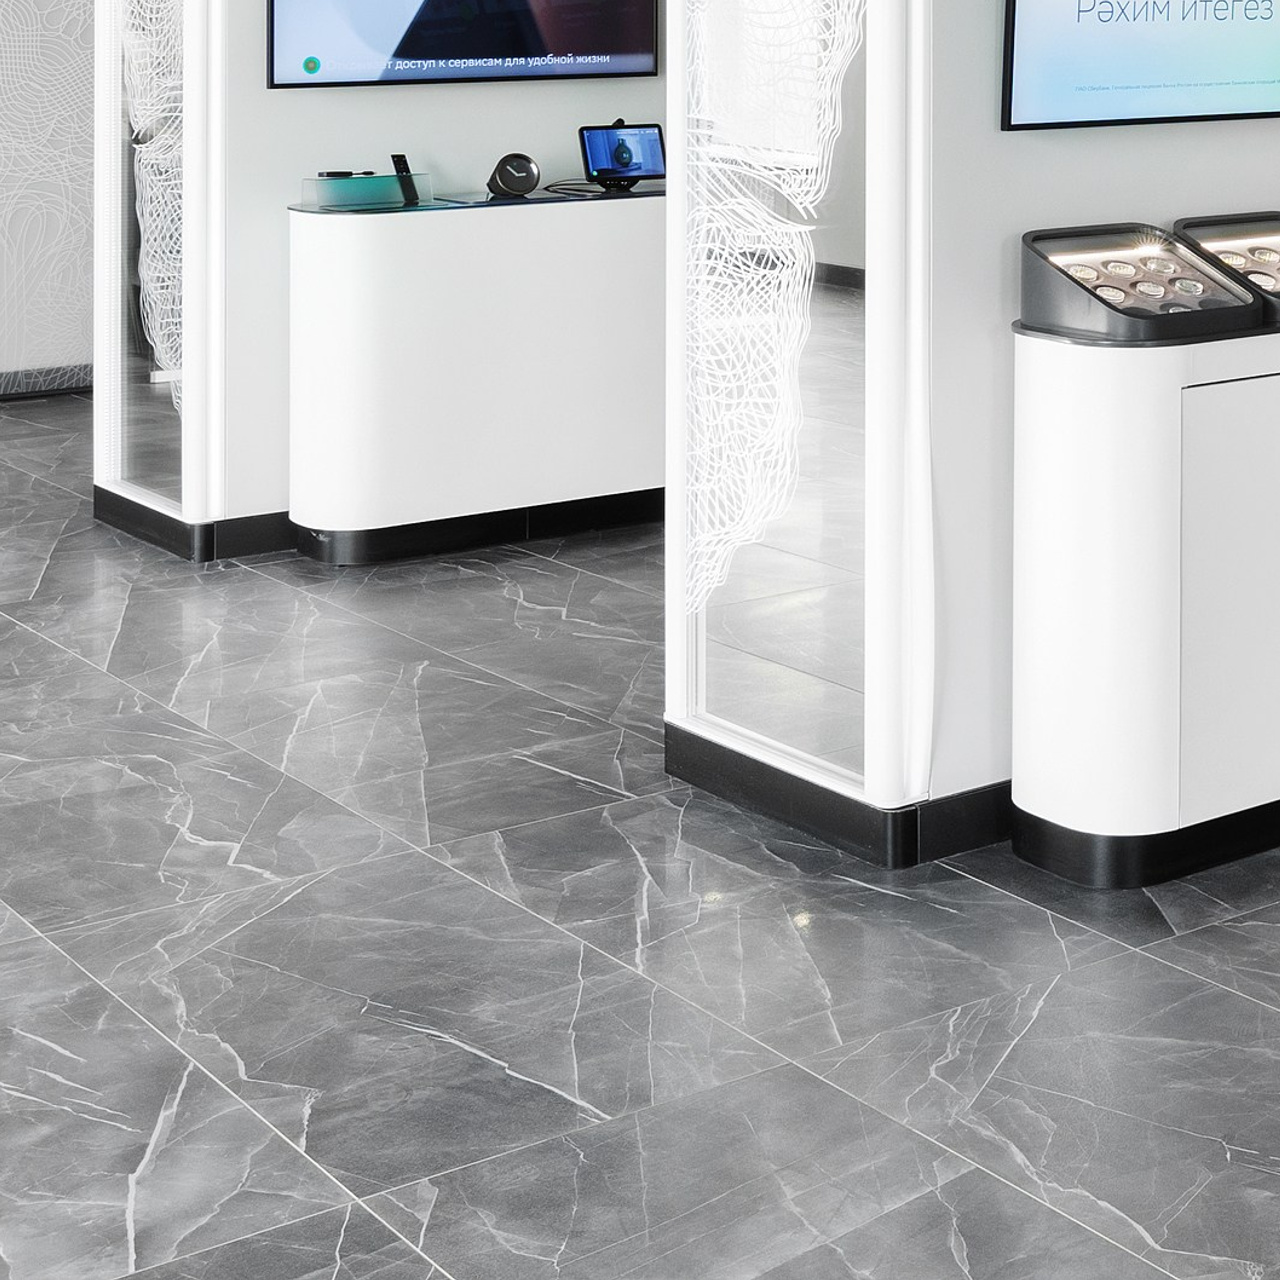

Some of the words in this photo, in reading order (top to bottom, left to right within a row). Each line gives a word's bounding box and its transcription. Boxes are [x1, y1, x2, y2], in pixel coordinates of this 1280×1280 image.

[395, 59, 435, 71] доступ
[439, 60, 446, 68] к
[449, 57, 502, 68] сервисам
[505, 58, 525, 67] для
[527, 54, 573, 67] удобной
[576, 54, 610, 64] жизни
